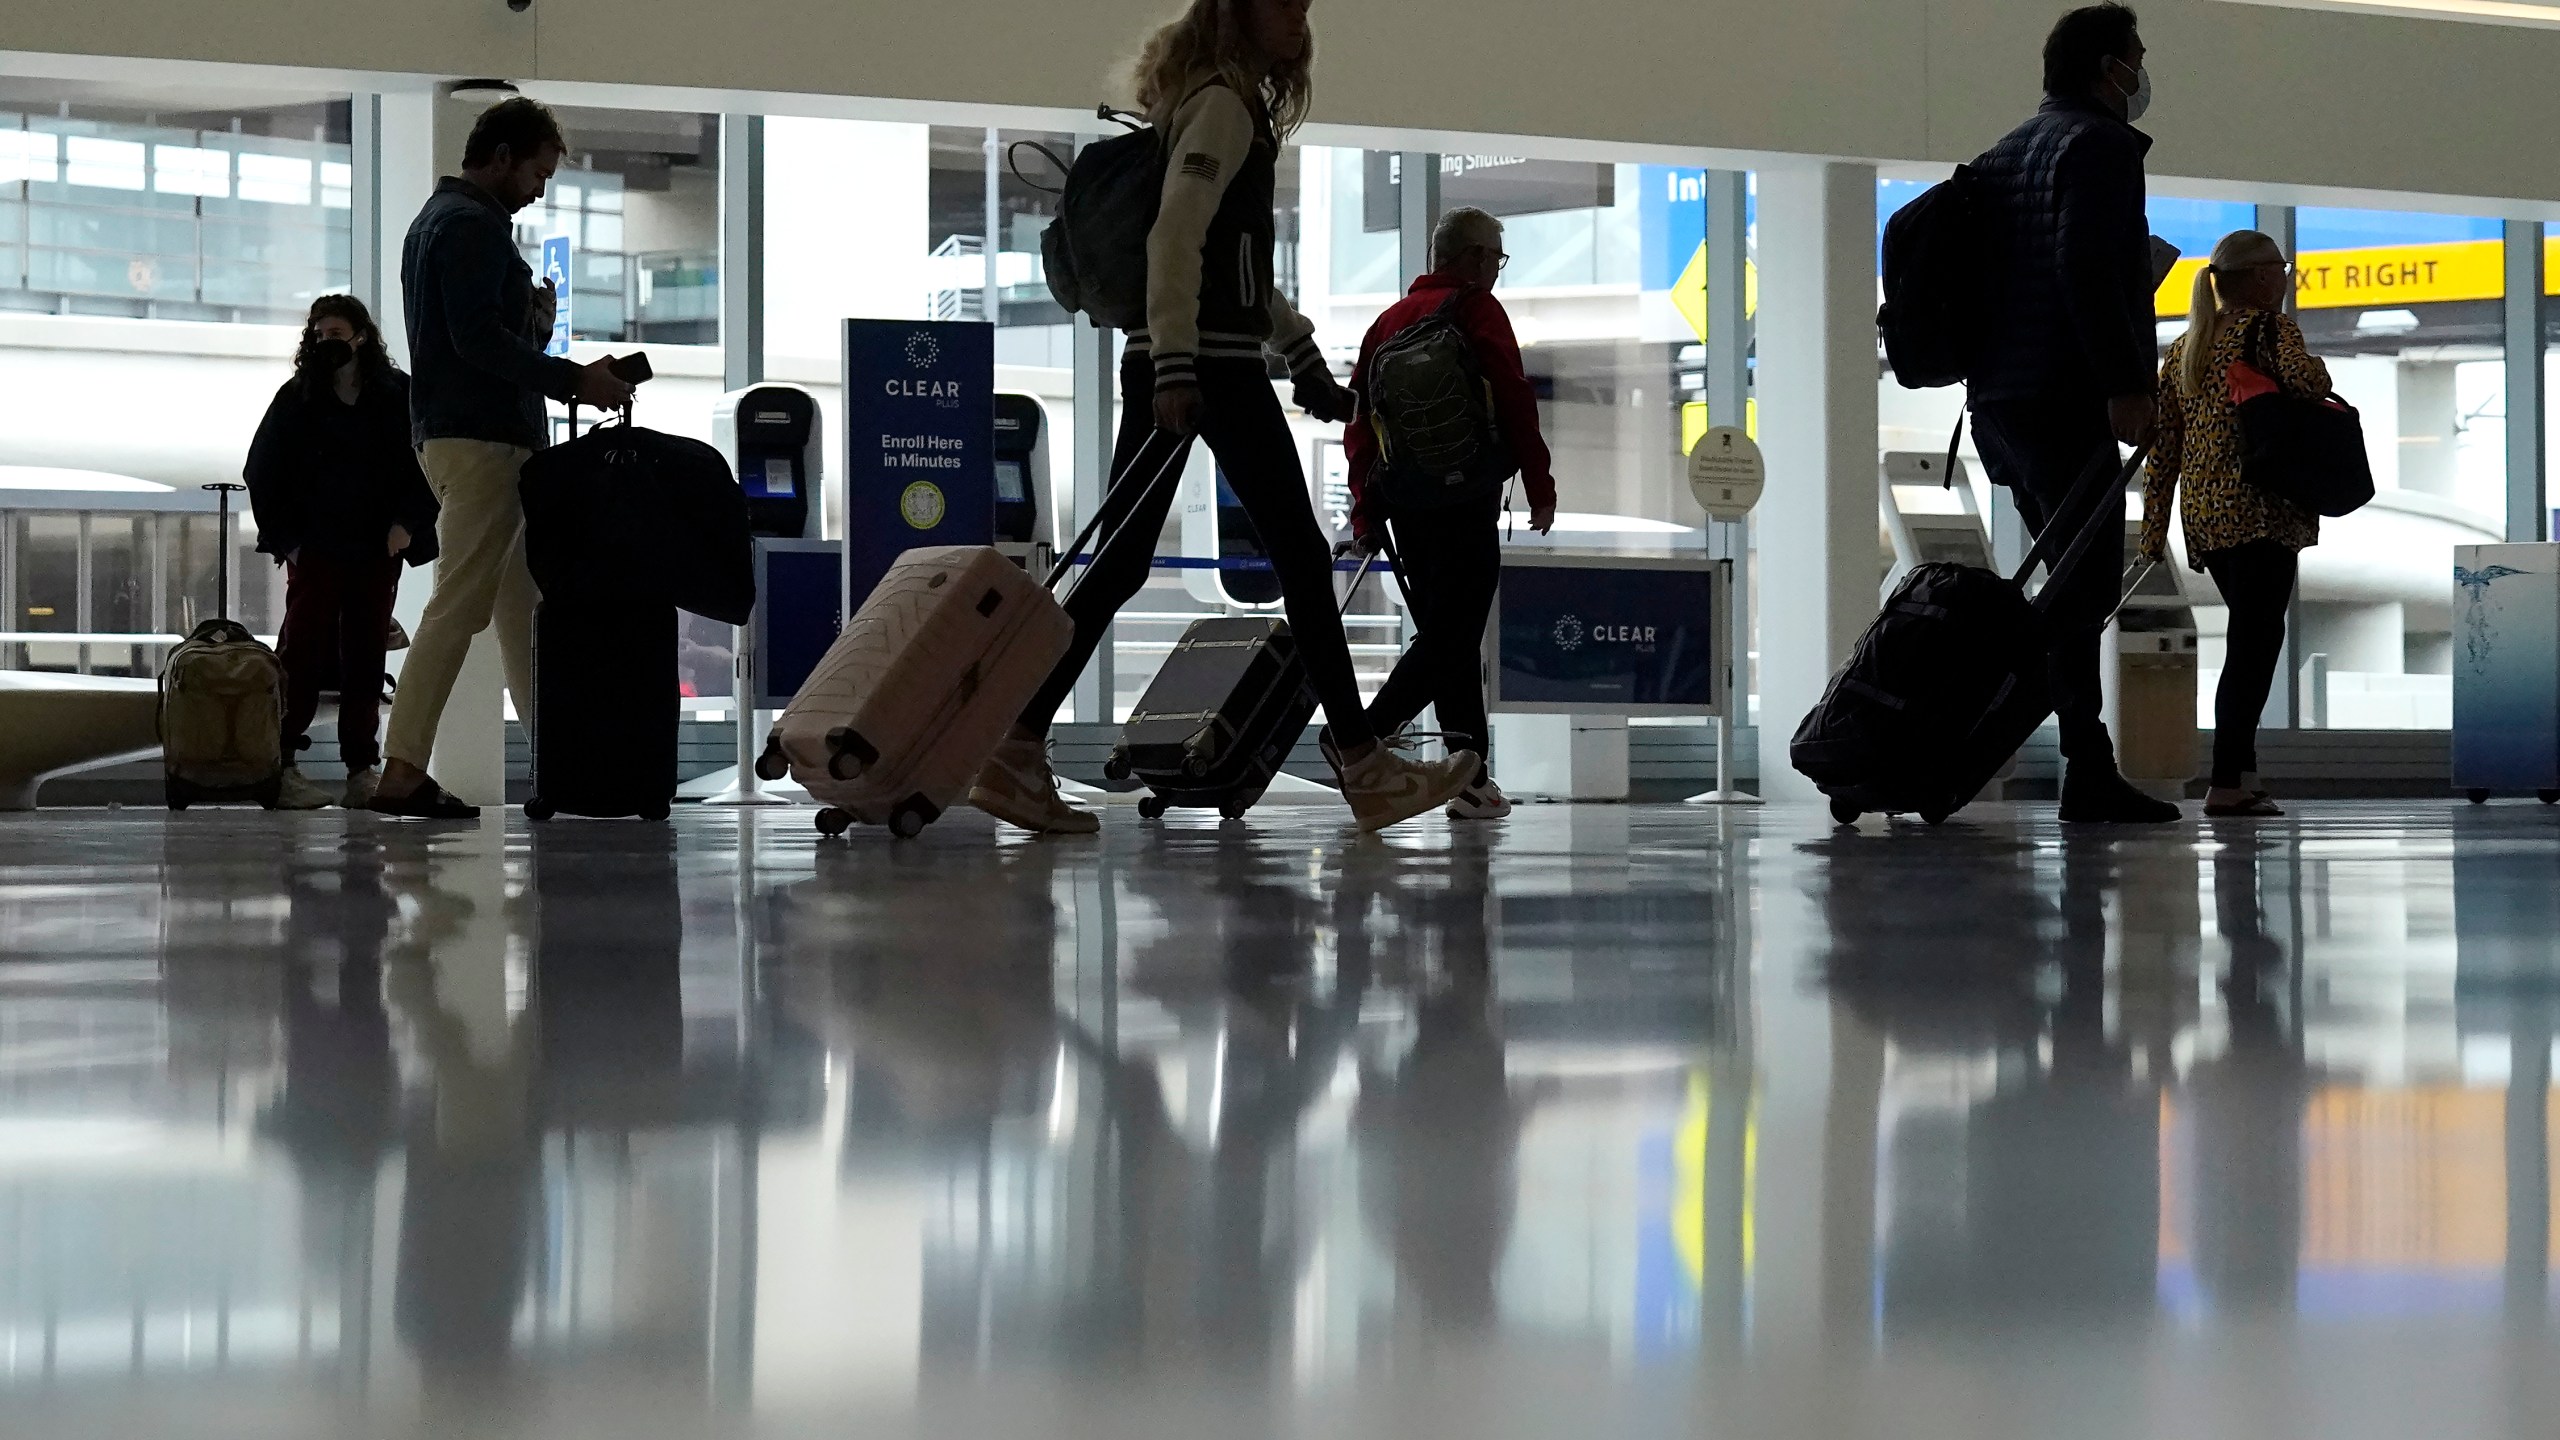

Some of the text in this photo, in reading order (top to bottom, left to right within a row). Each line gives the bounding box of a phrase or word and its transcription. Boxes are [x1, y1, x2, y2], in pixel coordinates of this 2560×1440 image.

[1440, 152, 1463, 177] ing
[2297, 260, 2438, 291] XT RIGHT
[885, 379, 960, 398] CLEAR
[936, 399, 960, 409] PLUS
[881, 434, 964, 450] Enroll Here
[884, 452, 962, 469] in Minutes
[1593, 625, 1656, 642] CLEAR
